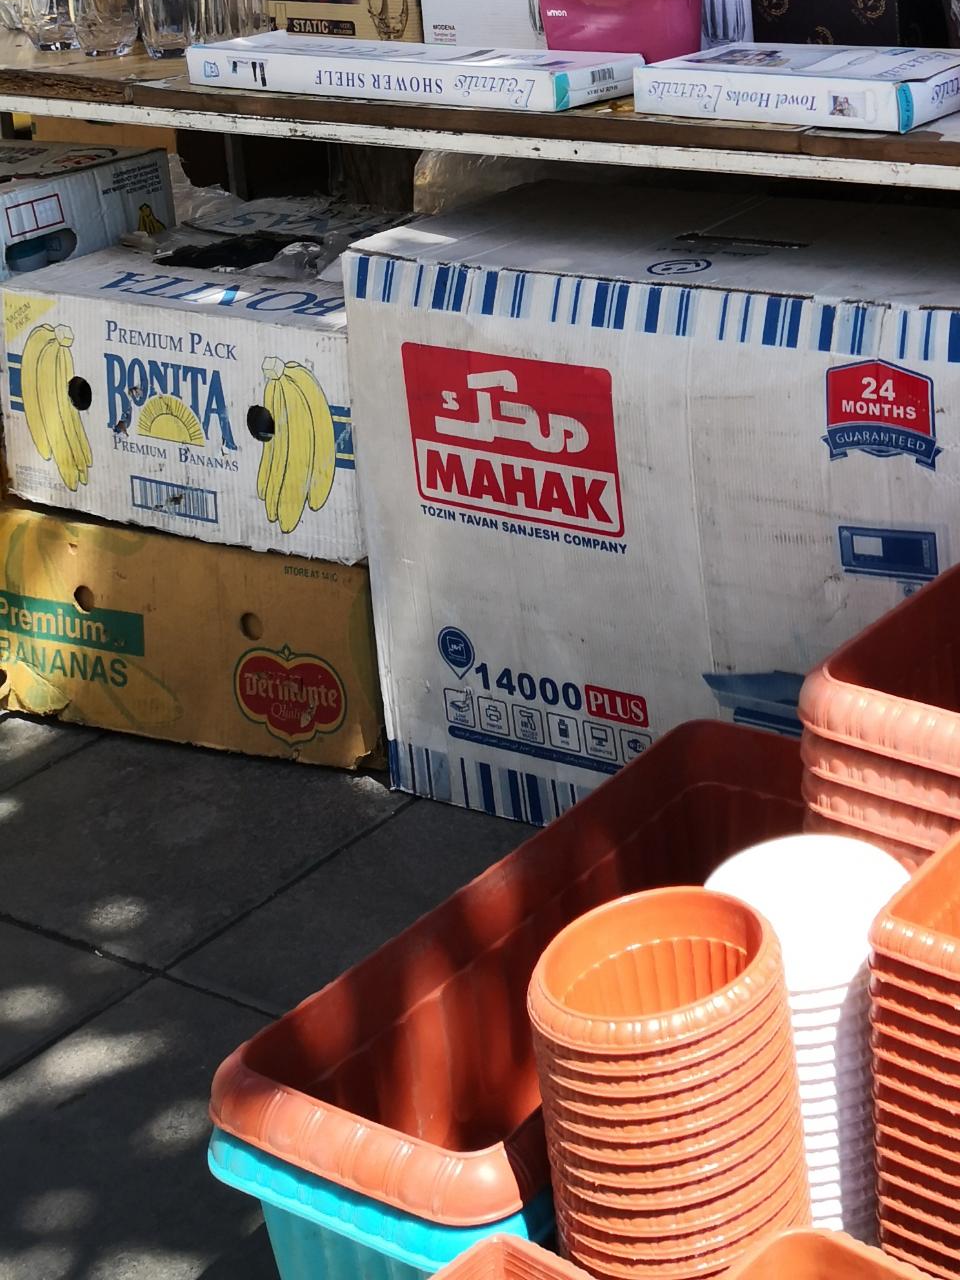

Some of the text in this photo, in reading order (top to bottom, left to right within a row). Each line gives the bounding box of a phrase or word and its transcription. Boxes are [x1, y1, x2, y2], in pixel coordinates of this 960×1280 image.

[293, 20, 329, 34] STATIC
[314, 69, 366, 88] SHELF
[372, 73, 443, 94] SHOWER
[726, 90, 771, 108] Hooks
[775, 93, 818, 111] Towel
[861, 376, 896, 402] 24
[103, 352, 238, 451] BONITA
[841, 399, 917, 420] MONTHS
[835, 430, 926, 451] GUARANTEED
[426, 447, 614, 525] MAHAK
[420, 504, 628, 555] TOZIN TAVAN SANJESH COMPANY
[0, 636, 129, 688] BANANAS
[475, 662, 646, 723] 14000 PLUS
